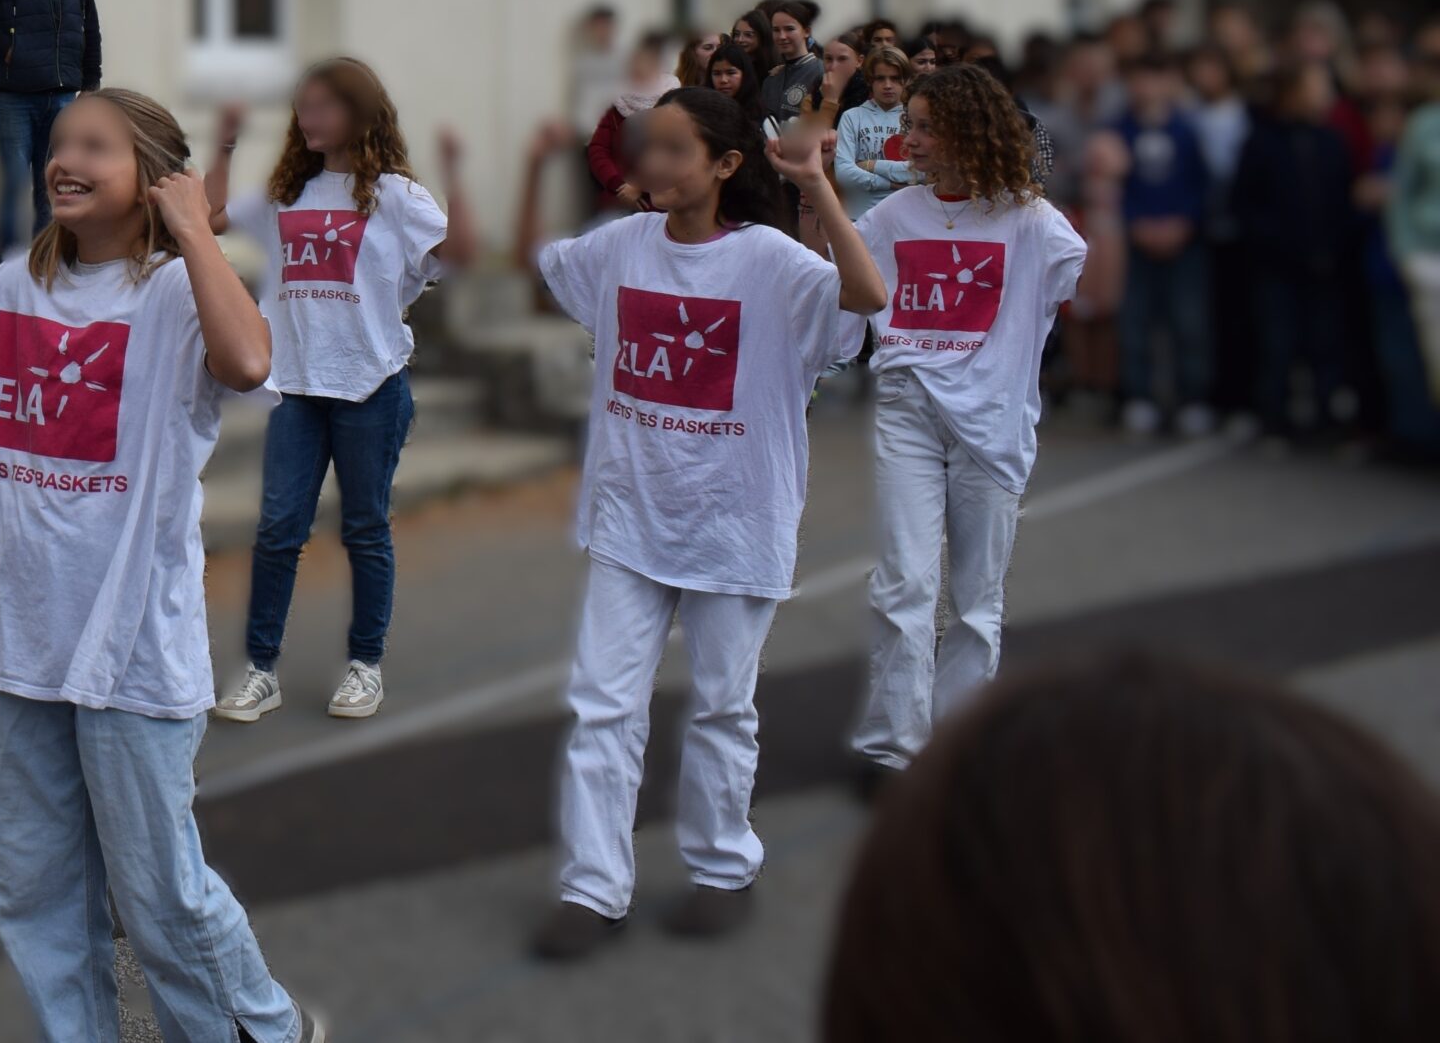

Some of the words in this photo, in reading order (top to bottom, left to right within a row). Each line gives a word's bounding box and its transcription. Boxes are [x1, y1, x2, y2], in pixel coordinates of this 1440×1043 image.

[288, 289, 308, 299] TES
[311, 289, 361, 304] BASKES
[900, 283, 946, 312] ELA
[662, 417, 745, 436] BASKETS
[34, 472, 128, 493] BASKETS
